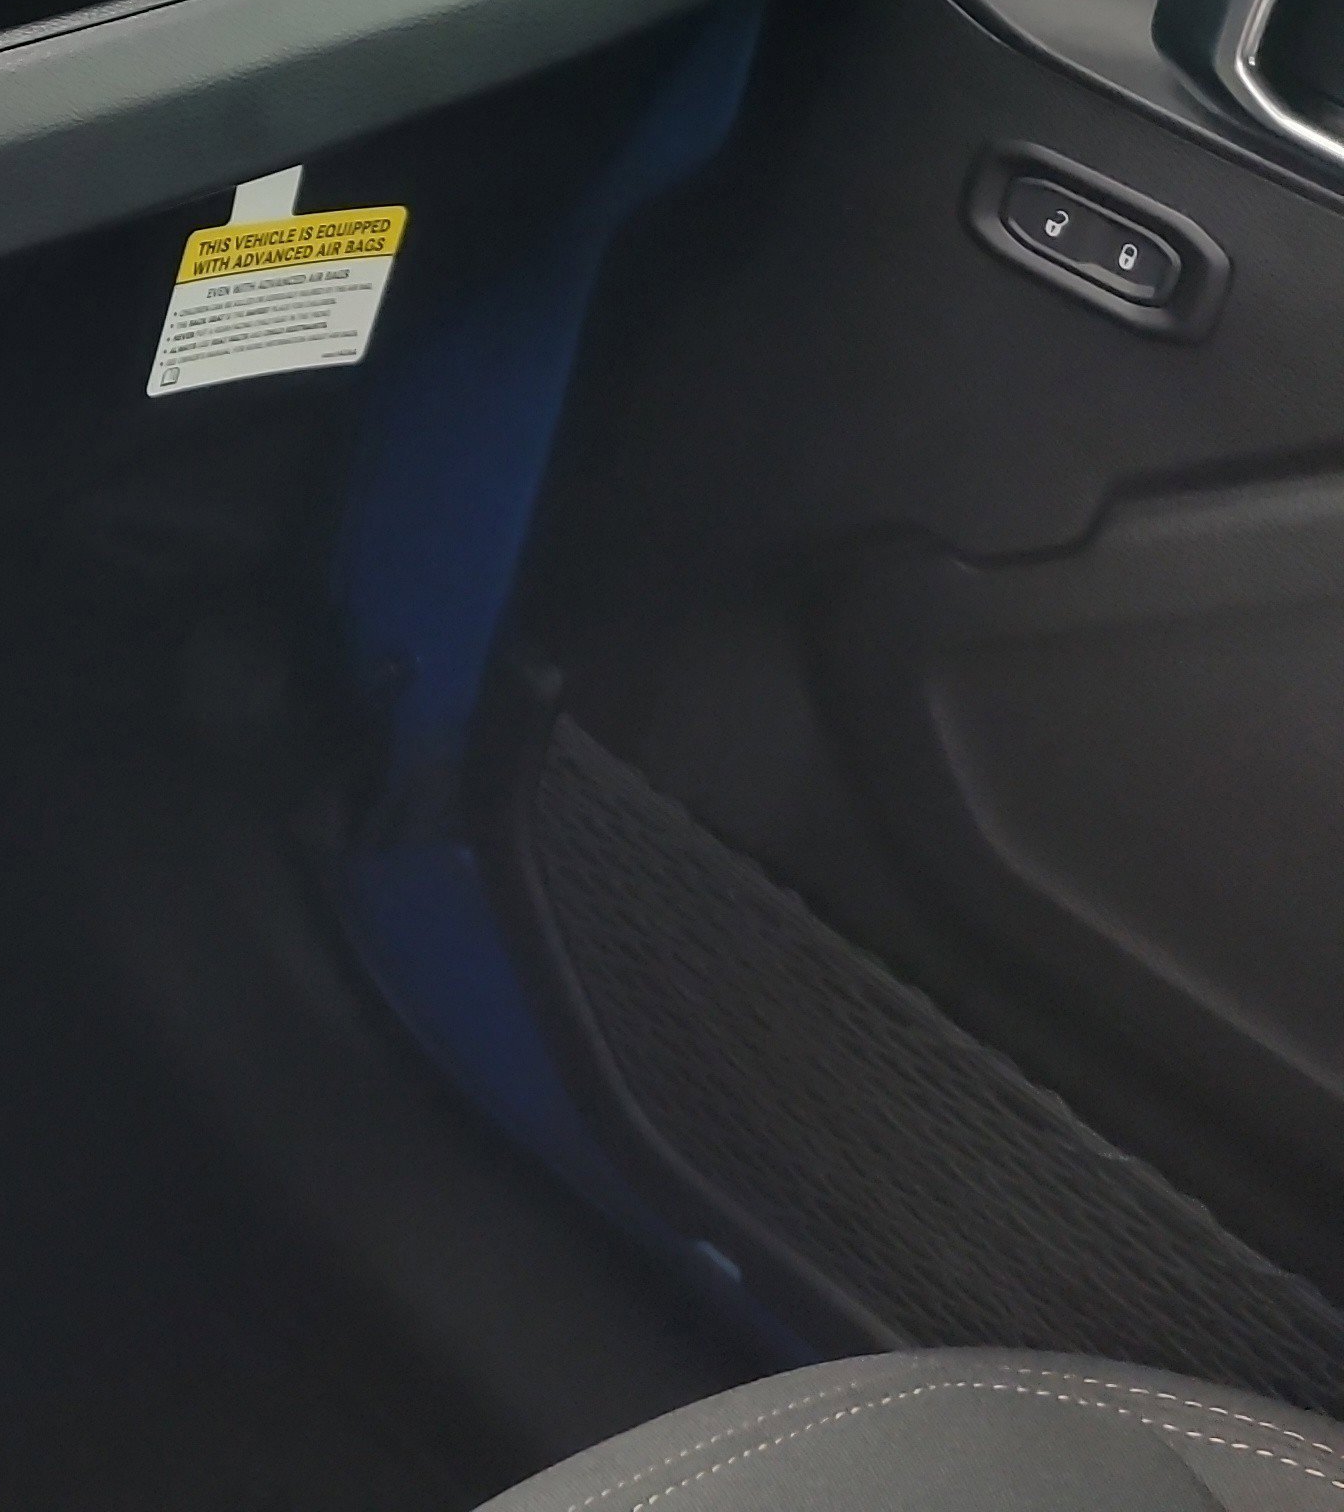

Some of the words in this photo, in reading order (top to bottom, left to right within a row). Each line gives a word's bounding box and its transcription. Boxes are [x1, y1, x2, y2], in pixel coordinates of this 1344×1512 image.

[193, 256, 231, 276] WITH
[233, 244, 313, 269] ADVANCED
[316, 241, 342, 257] AIR
[345, 237, 385, 253] BAGS
[199, 238, 229, 256] THIS
[236, 228, 297, 250] VEHICLE
[298, 226, 314, 242] IS
[316, 219, 391, 239] EQUIPPED
